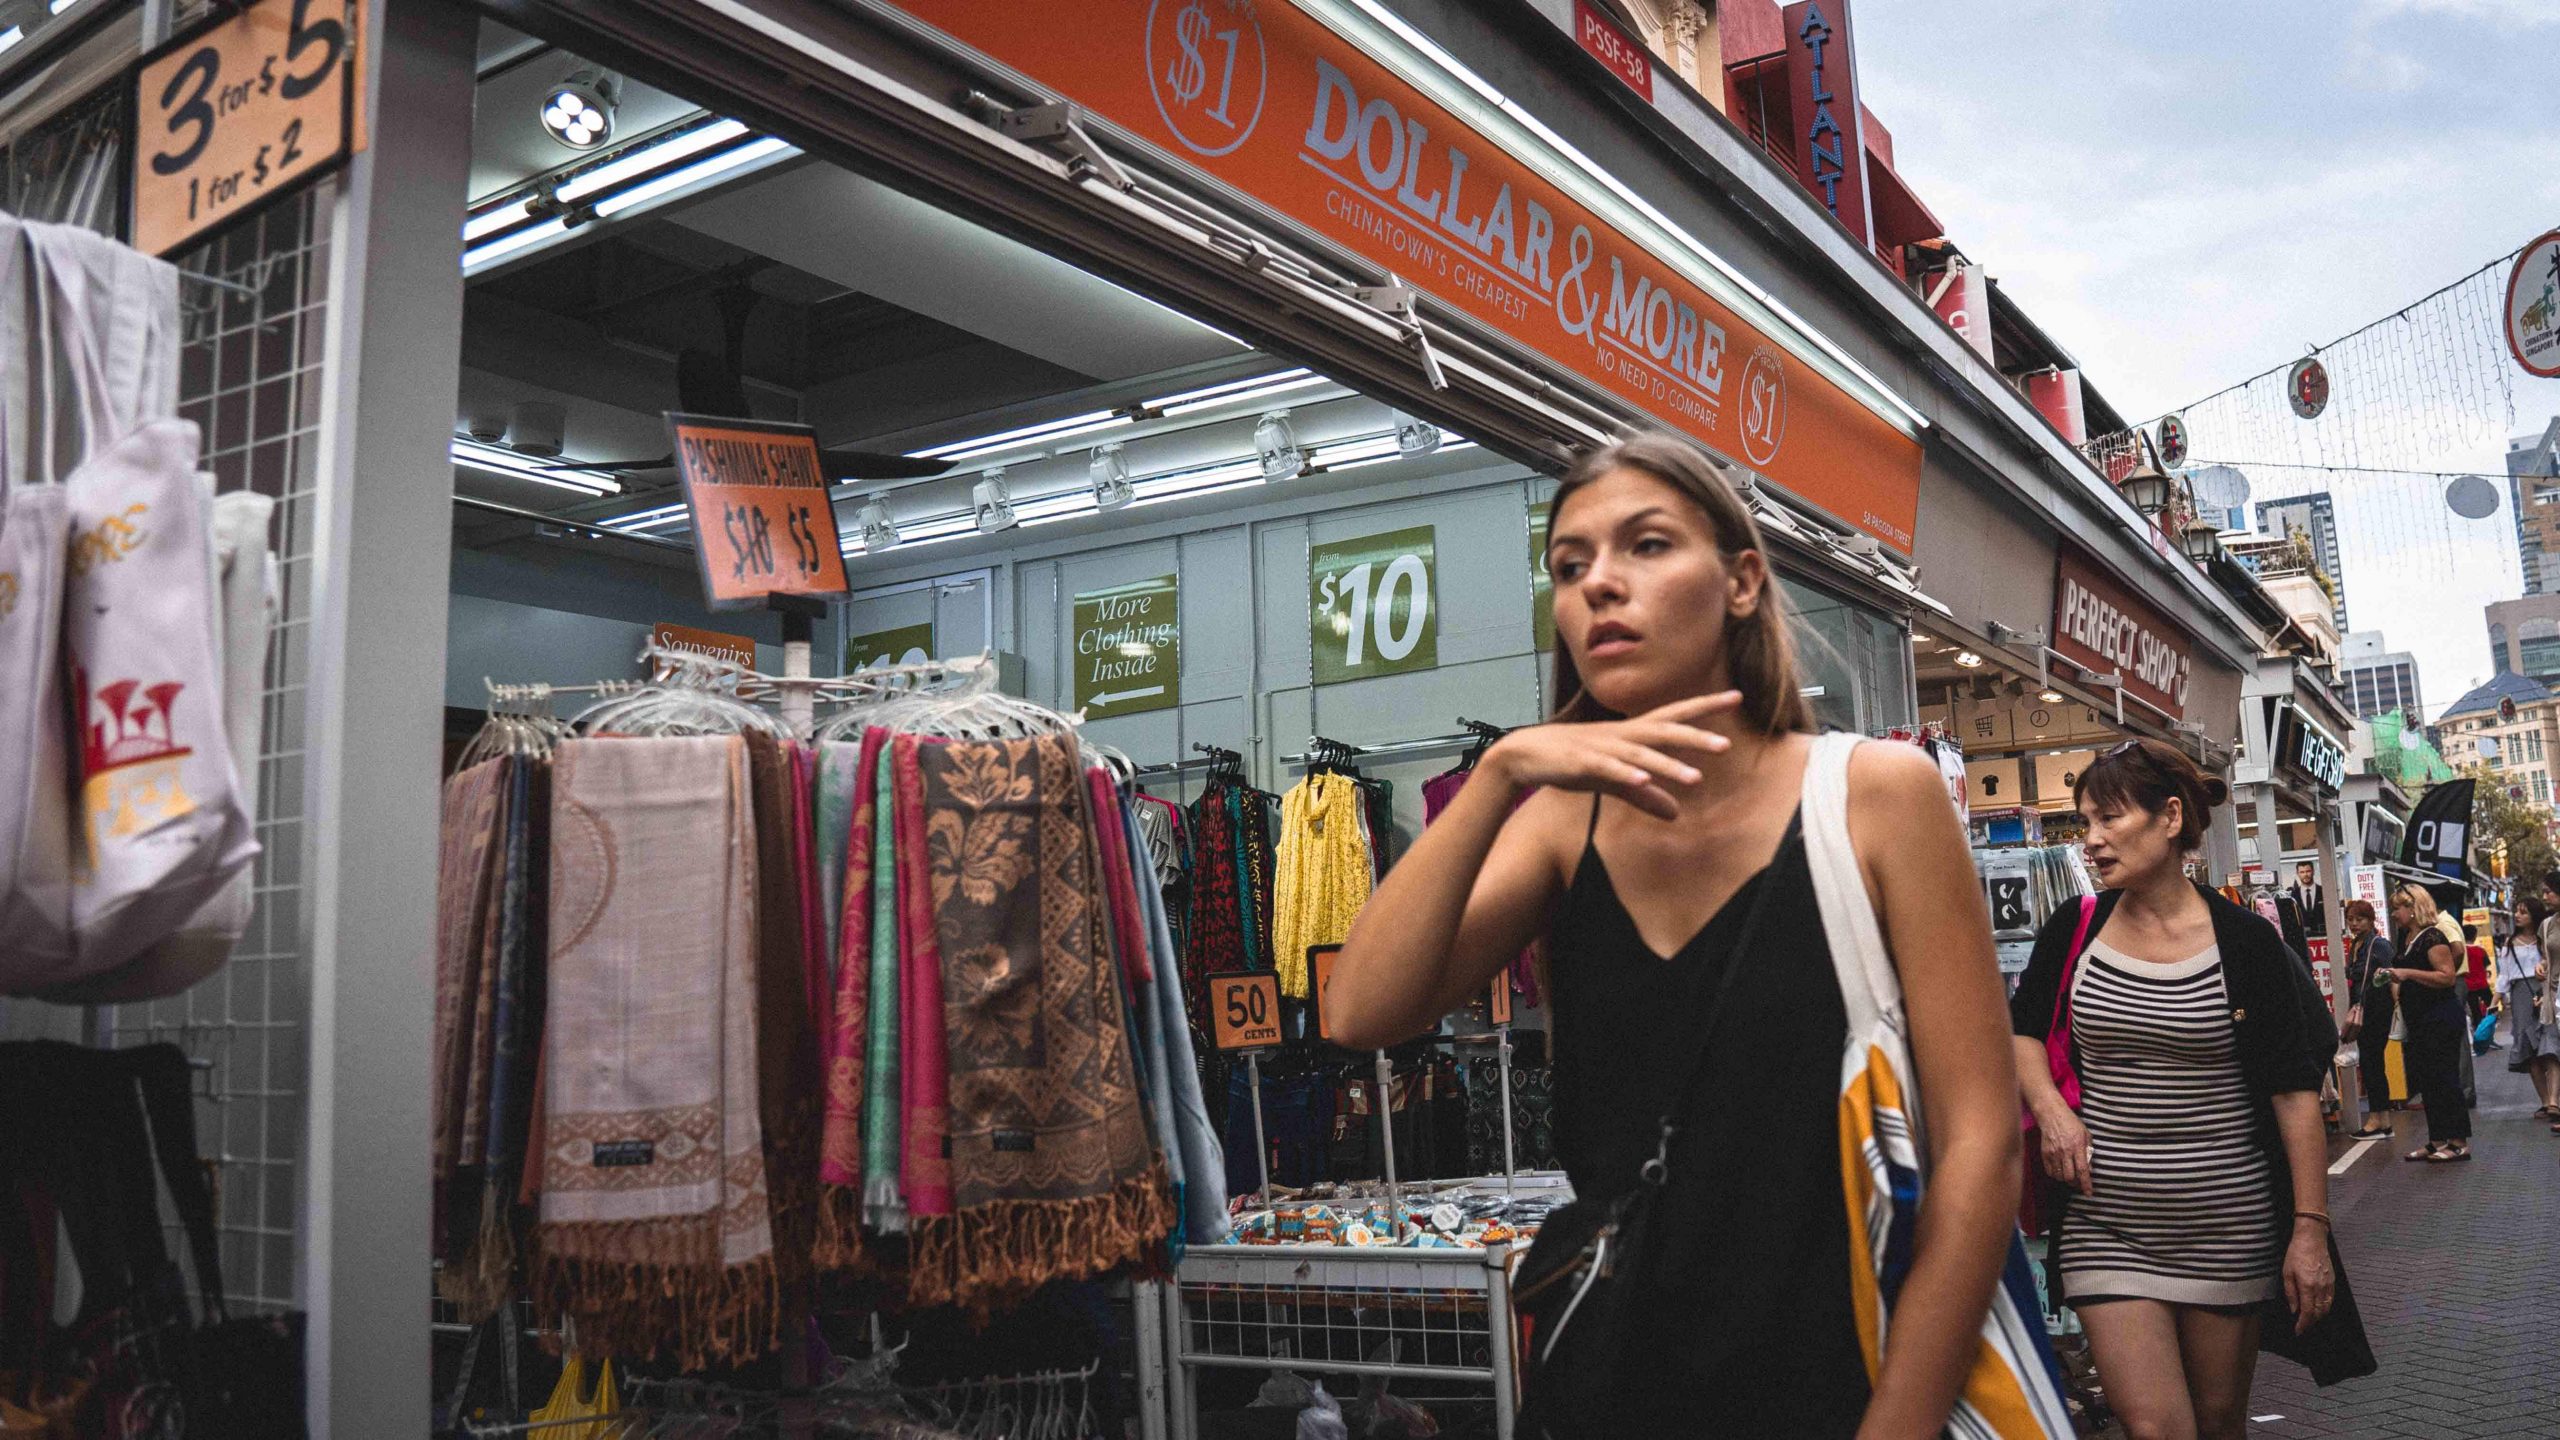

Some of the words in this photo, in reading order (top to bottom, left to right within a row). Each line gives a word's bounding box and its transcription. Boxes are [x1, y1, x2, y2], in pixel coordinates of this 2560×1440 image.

[1165, 0, 1240, 130] $1
[1585, 14, 1645, 86] PSSF-58
[151, 46, 220, 176] 3
[218, 77, 255, 118] for
[1799, 1, 1845, 218] ATLANT
[208, 171, 245, 210] for
[1304, 56, 1554, 293] DOLLAR
[1556, 224, 1600, 347] &
[1602, 255, 1727, 395] MORE
[1326, 190, 1448, 277] CHINATOWN'S
[1454, 263, 1529, 322] CHEAPEST
[2525, 338, 2554, 359] SINGAPORE
[1596, 346, 1615, 373] NO
[1618, 358, 1649, 391] NEED
[1649, 377, 1666, 401] TO
[1669, 388, 1718, 432] COMPARE
[1747, 369, 1778, 446] $1
[684, 436, 770, 485] PASHMINA
[787, 502, 820, 581] $5
[1094, 595, 1152, 623] More
[1317, 553, 1429, 667] $10
[661, 631, 752, 666] Souvenirs
[1079, 621, 1172, 655] Clothing
[2060, 578, 2138, 671] PERFECT
[2135, 629, 2177, 695] SHOP
[1091, 654, 1157, 683] Inside
[2300, 722, 2317, 773] THE
[2357, 873, 2374, 882] DUTY
[2359, 882, 2376, 891] FREE
[1226, 983, 1267, 1029] 50
[1244, 1027, 1277, 1040] CENTS
